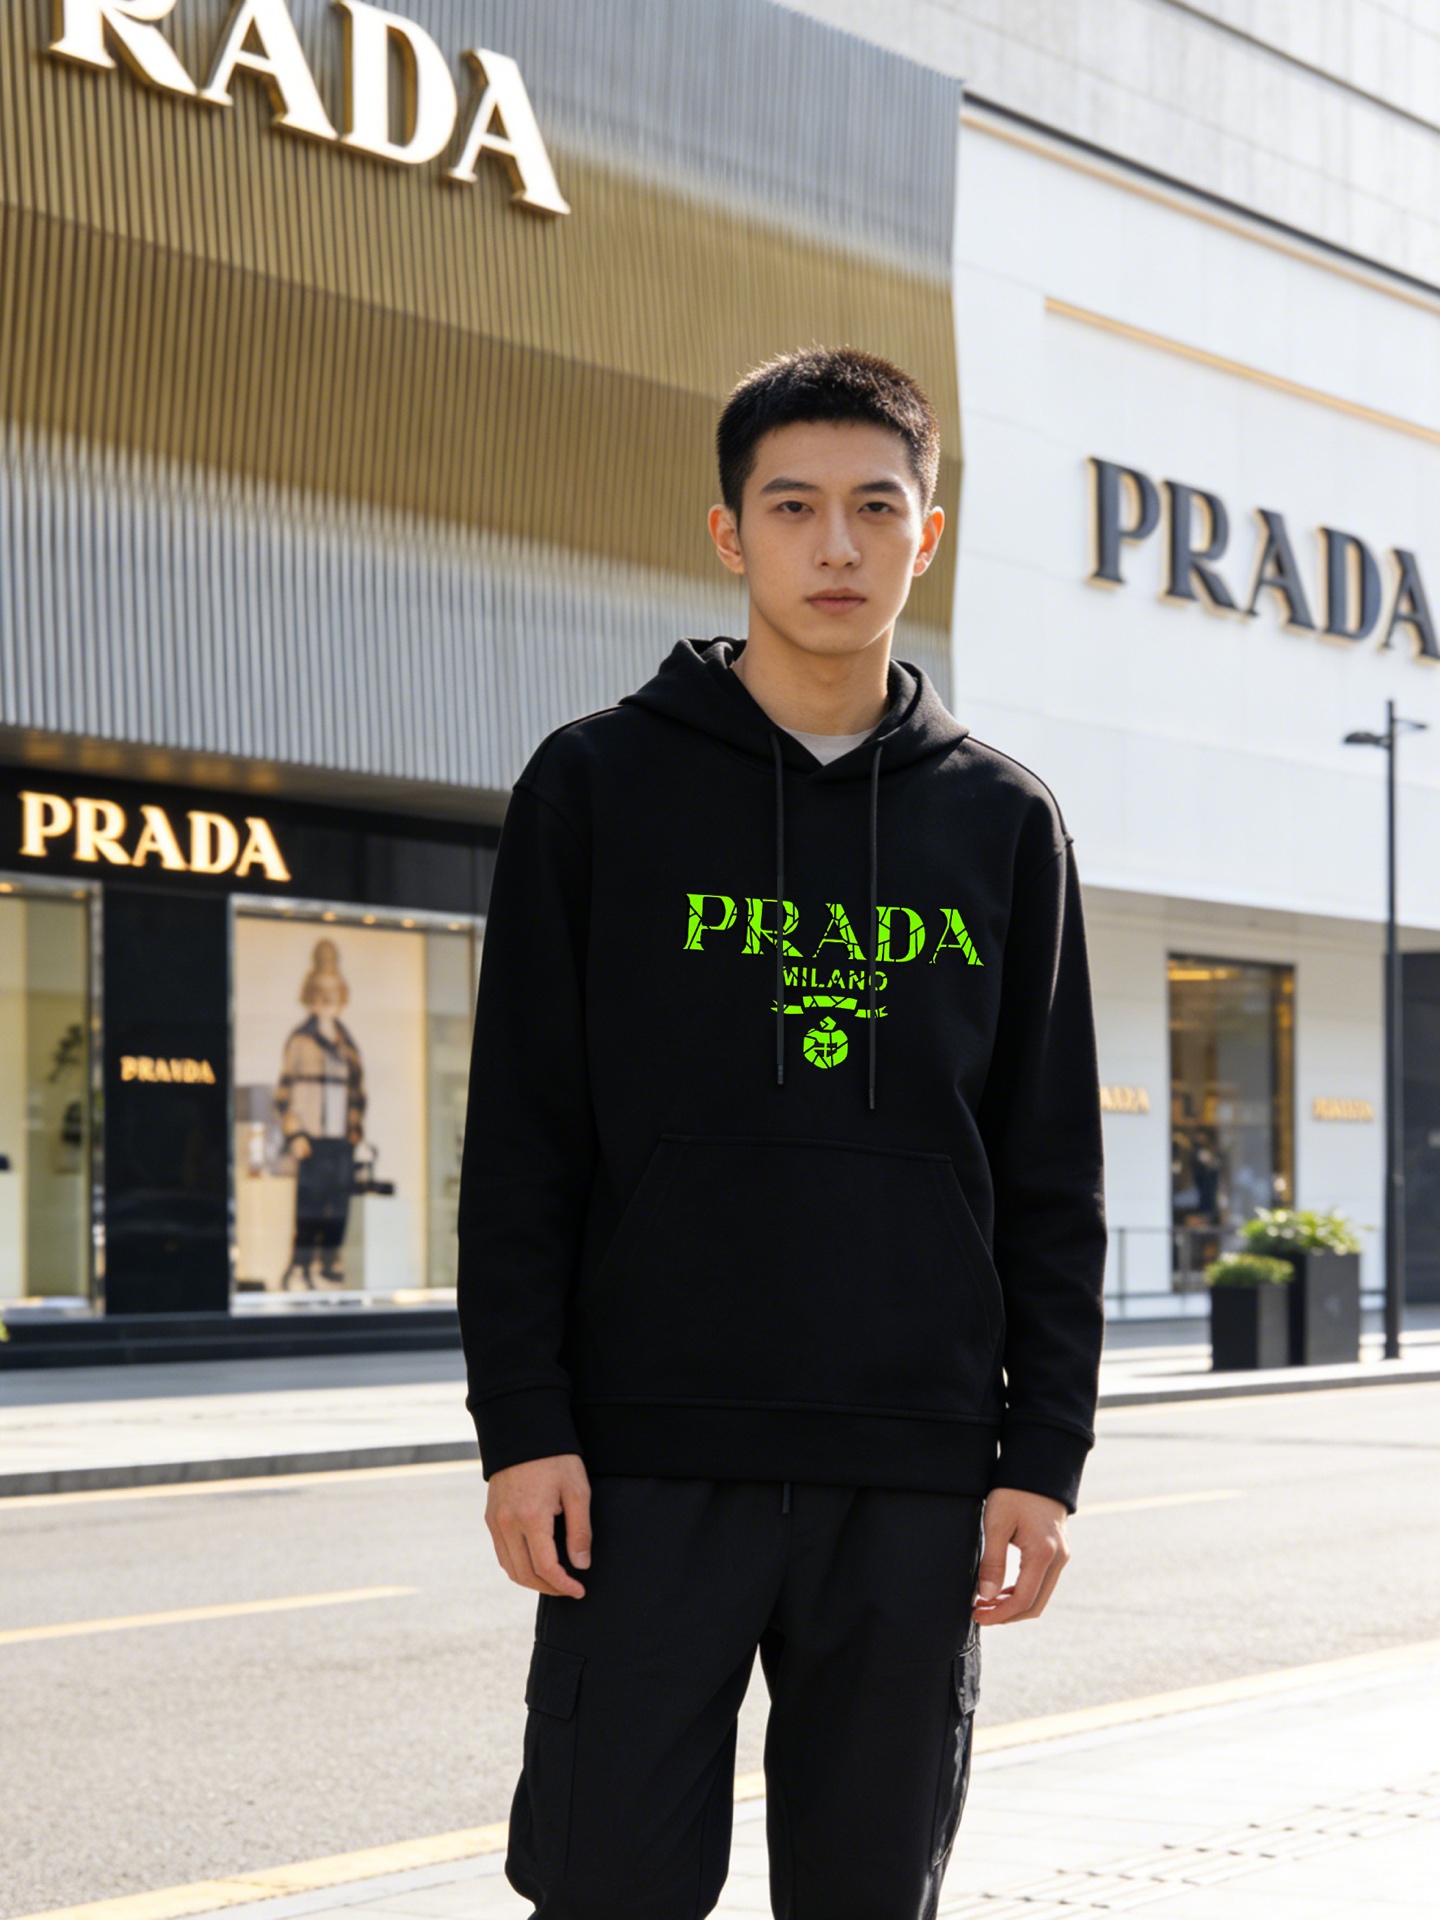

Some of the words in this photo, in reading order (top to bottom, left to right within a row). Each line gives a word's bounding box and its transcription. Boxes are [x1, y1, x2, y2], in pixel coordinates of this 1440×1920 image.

[1085, 456, 1440, 664] PRADA
[19, 790, 292, 882] PRADA
[683, 893, 984, 967] PRADA
[782, 966, 888, 991] MILANO
